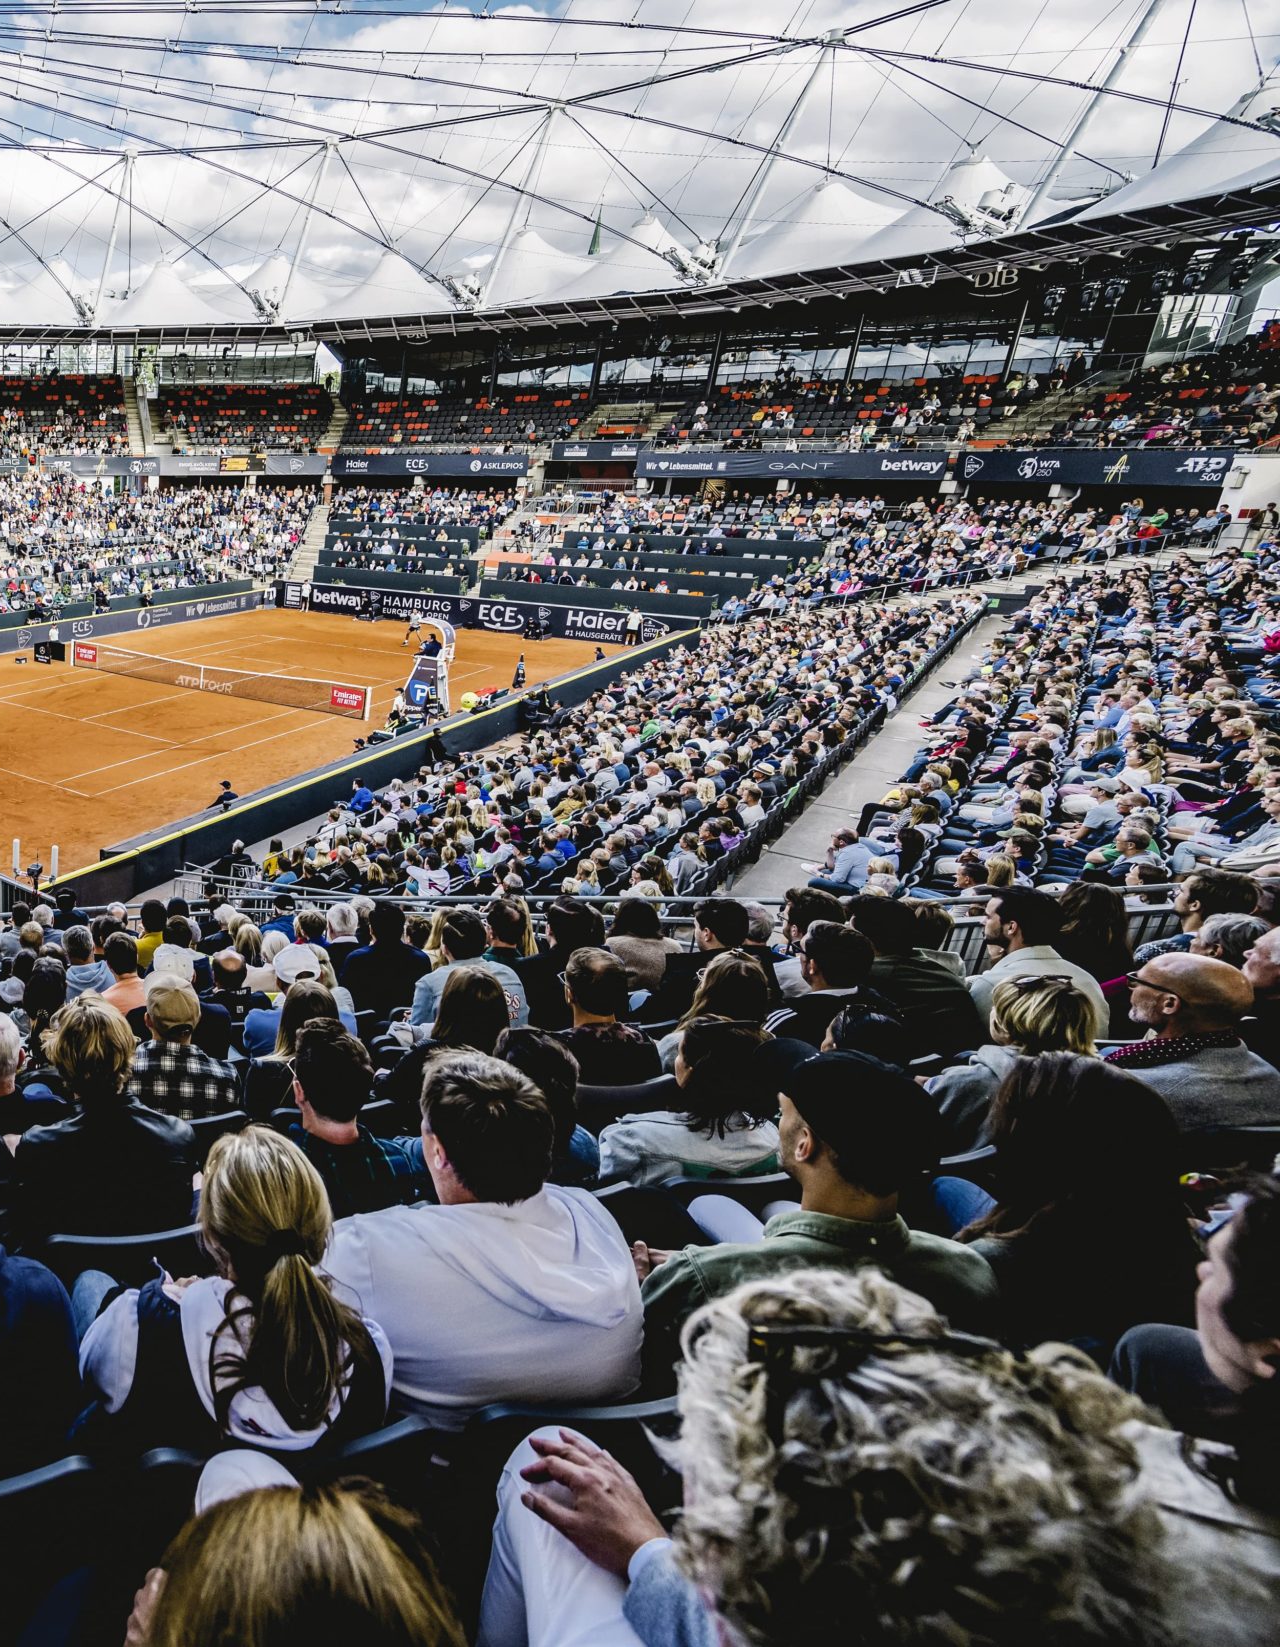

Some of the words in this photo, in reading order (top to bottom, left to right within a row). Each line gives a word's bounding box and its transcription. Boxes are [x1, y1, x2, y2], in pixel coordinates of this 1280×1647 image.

[345, 459, 369, 468] Haier
[482, 462, 524, 470] ASKLEPIOS
[646, 462, 658, 470] Wir
[768, 462, 835, 470] GANT
[880, 459, 944, 474] betway
[1039, 460, 1061, 469] WTA
[1175, 457, 1228, 473] ATP
[1036, 468, 1052, 477] 250
[1199, 473, 1222, 481] 500
[312, 589, 362, 610] betway
[383, 595, 452, 612] HAMBURG
[185, 605, 196, 617] Wir
[382, 607, 424, 619] EUROPEN
[426, 612, 450, 621] OPEN
[478, 604, 518, 623] ECE
[566, 610, 625, 632] Haier
[575, 630, 623, 642] HAUSGERÄTE
[175, 674, 199, 688] ATP
[201, 679, 233, 694] TOUR
[333, 690, 362, 701] Emirates
